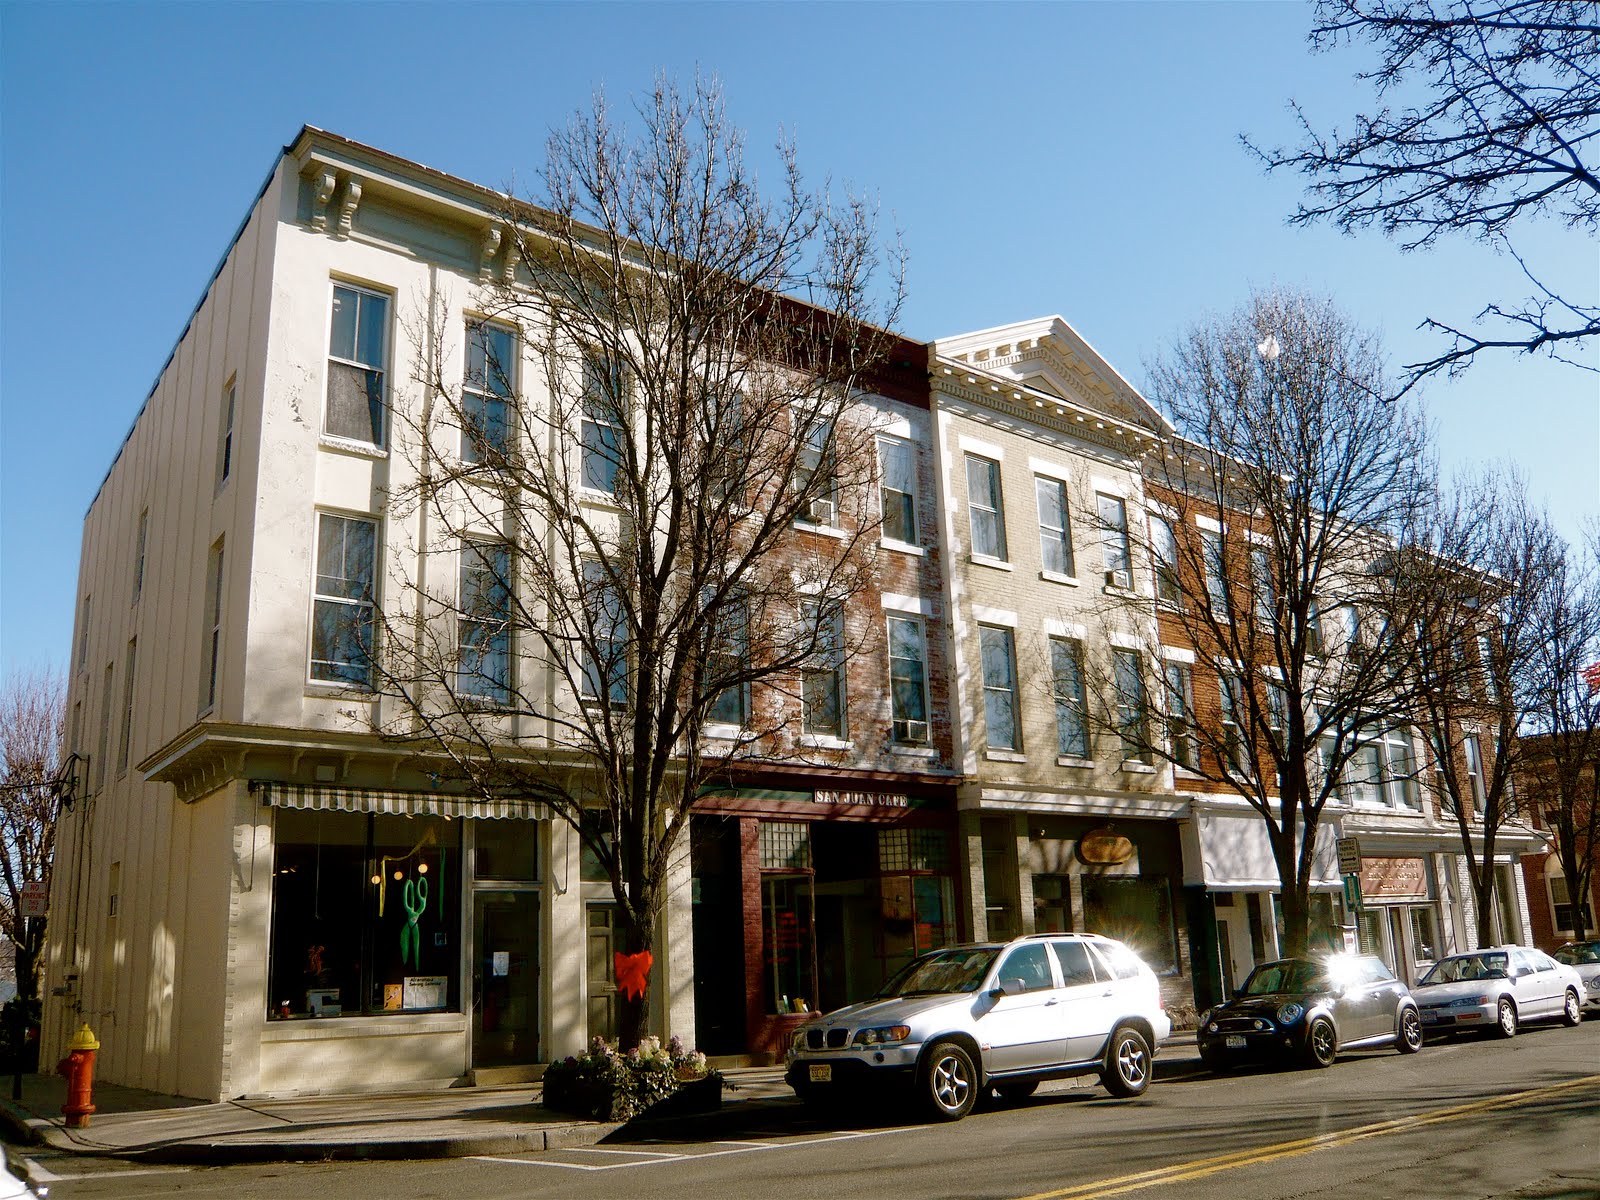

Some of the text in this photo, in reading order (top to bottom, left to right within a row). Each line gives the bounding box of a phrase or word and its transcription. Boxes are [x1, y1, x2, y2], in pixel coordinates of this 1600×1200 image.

[816, 790, 908, 807] SAN JUAN CAFE
